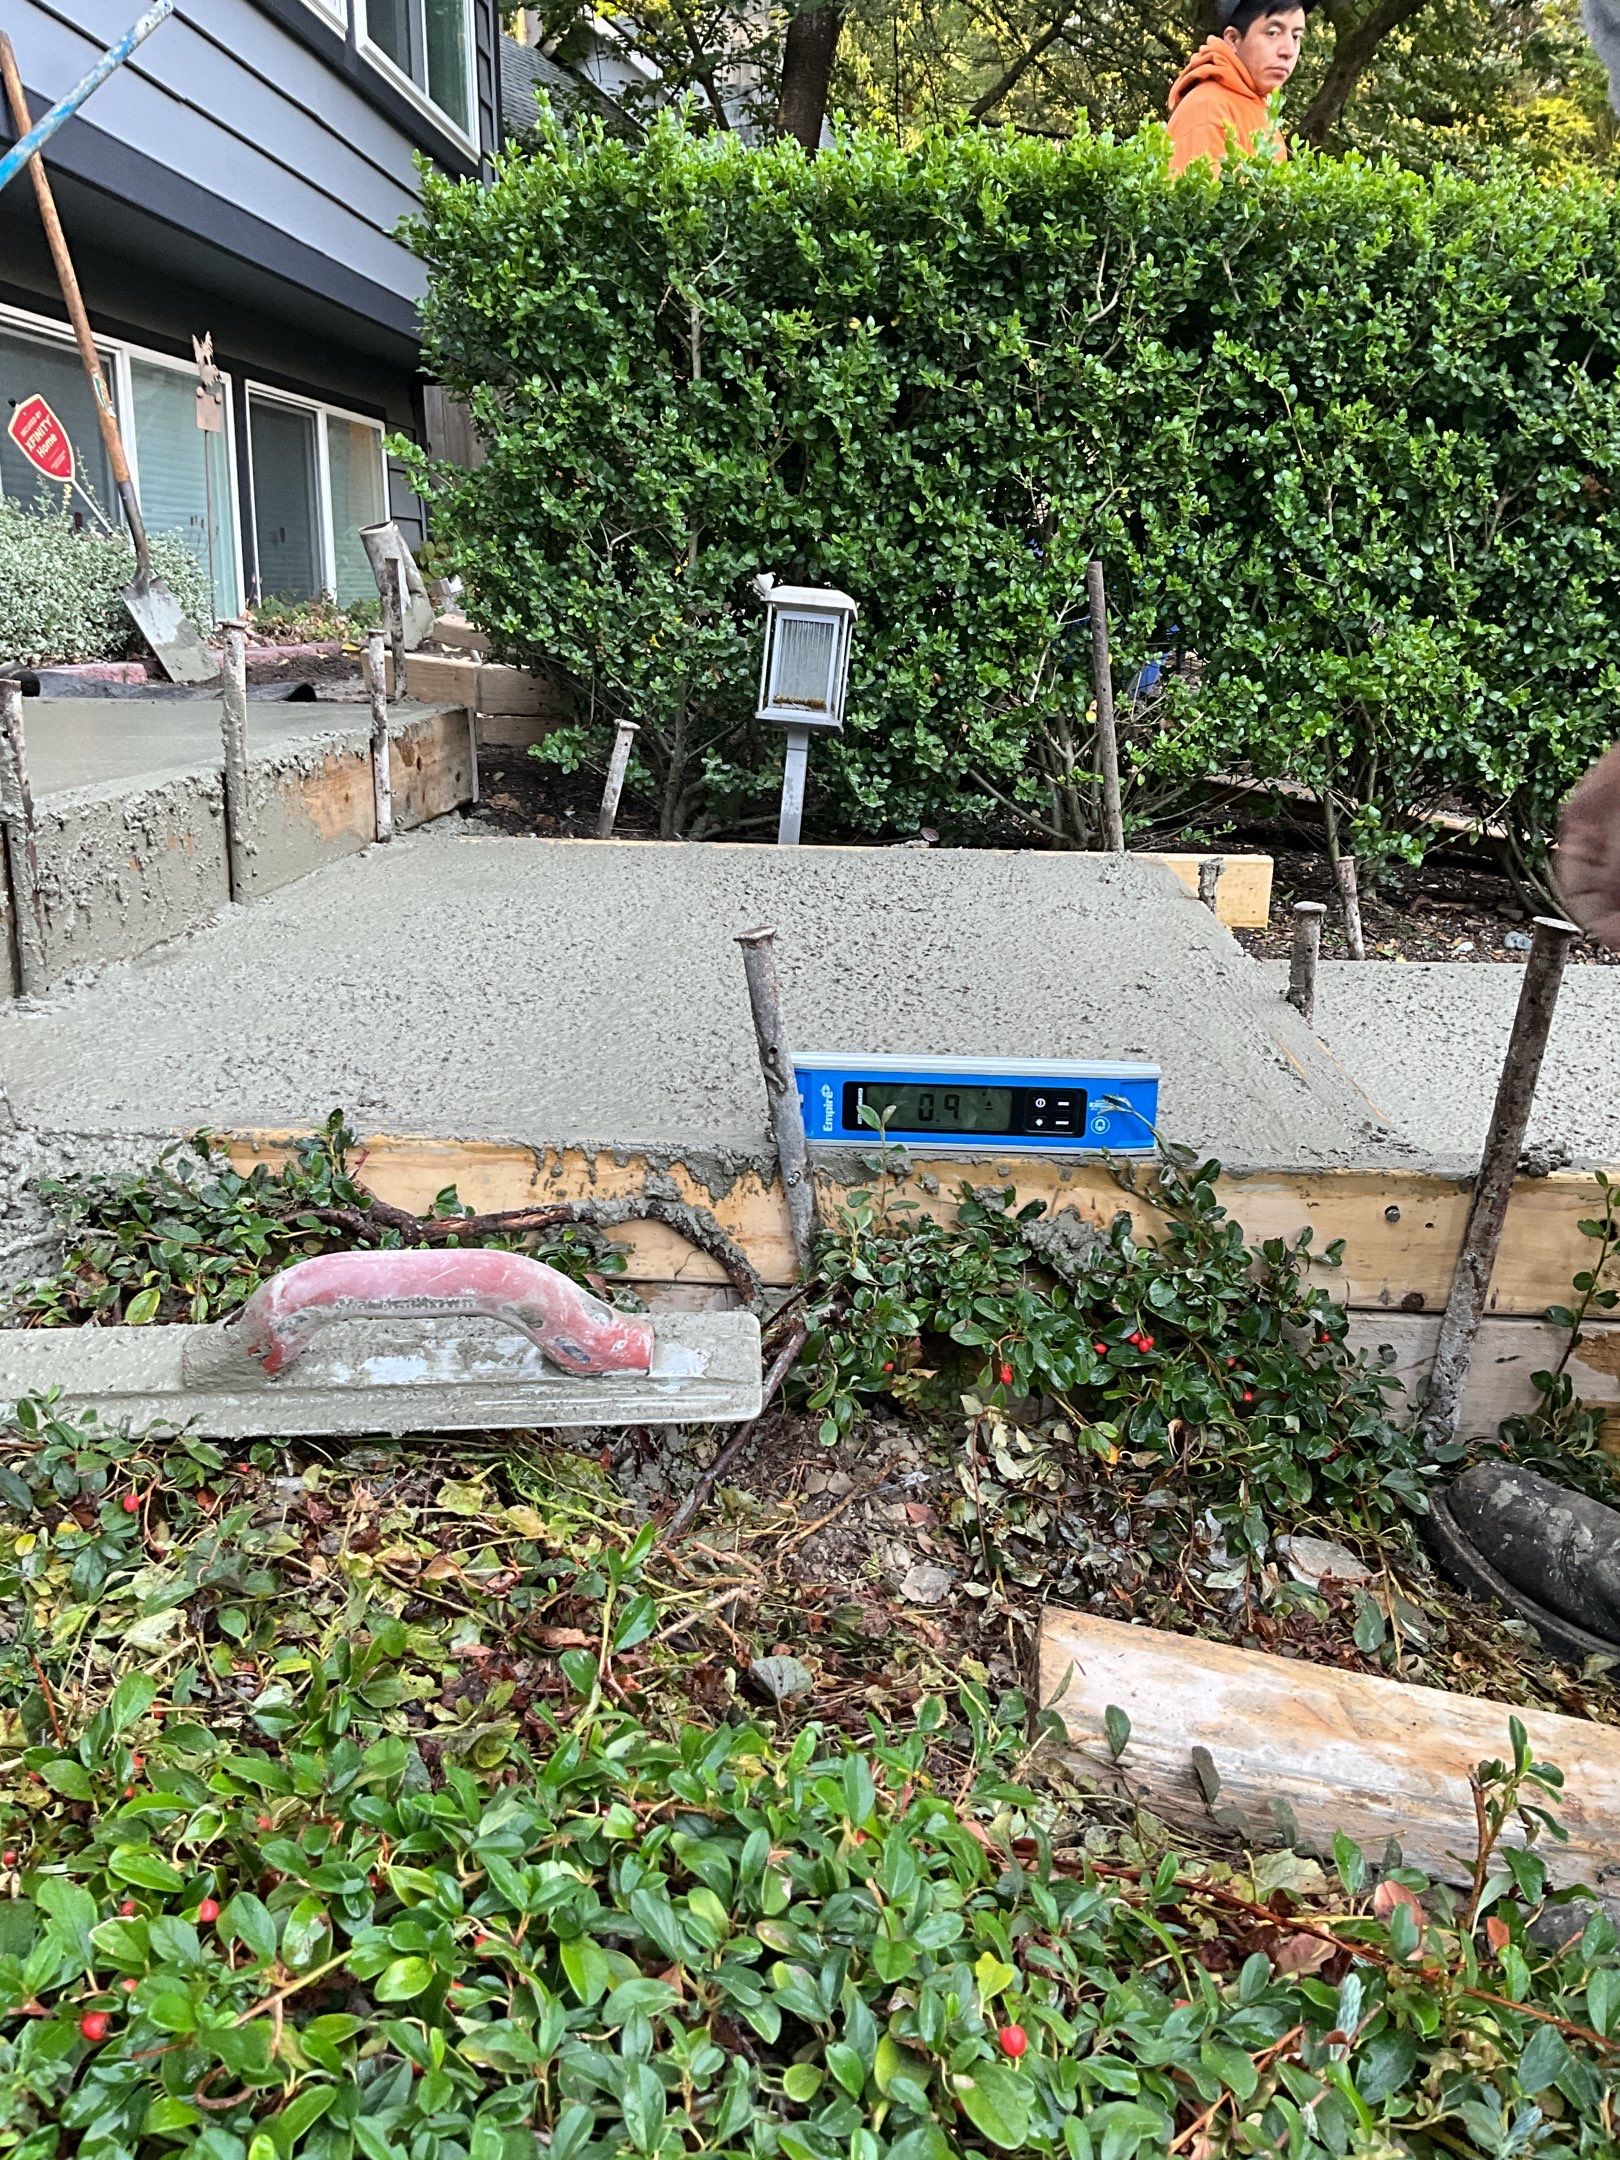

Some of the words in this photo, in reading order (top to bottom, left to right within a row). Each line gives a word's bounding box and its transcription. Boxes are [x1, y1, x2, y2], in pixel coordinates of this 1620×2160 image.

[25, 414, 53, 452] XFINITY
[36, 433, 58, 459] Home
[823, 1091, 835, 1132] Empire
[918, 1093, 960, 1122] 0.9
